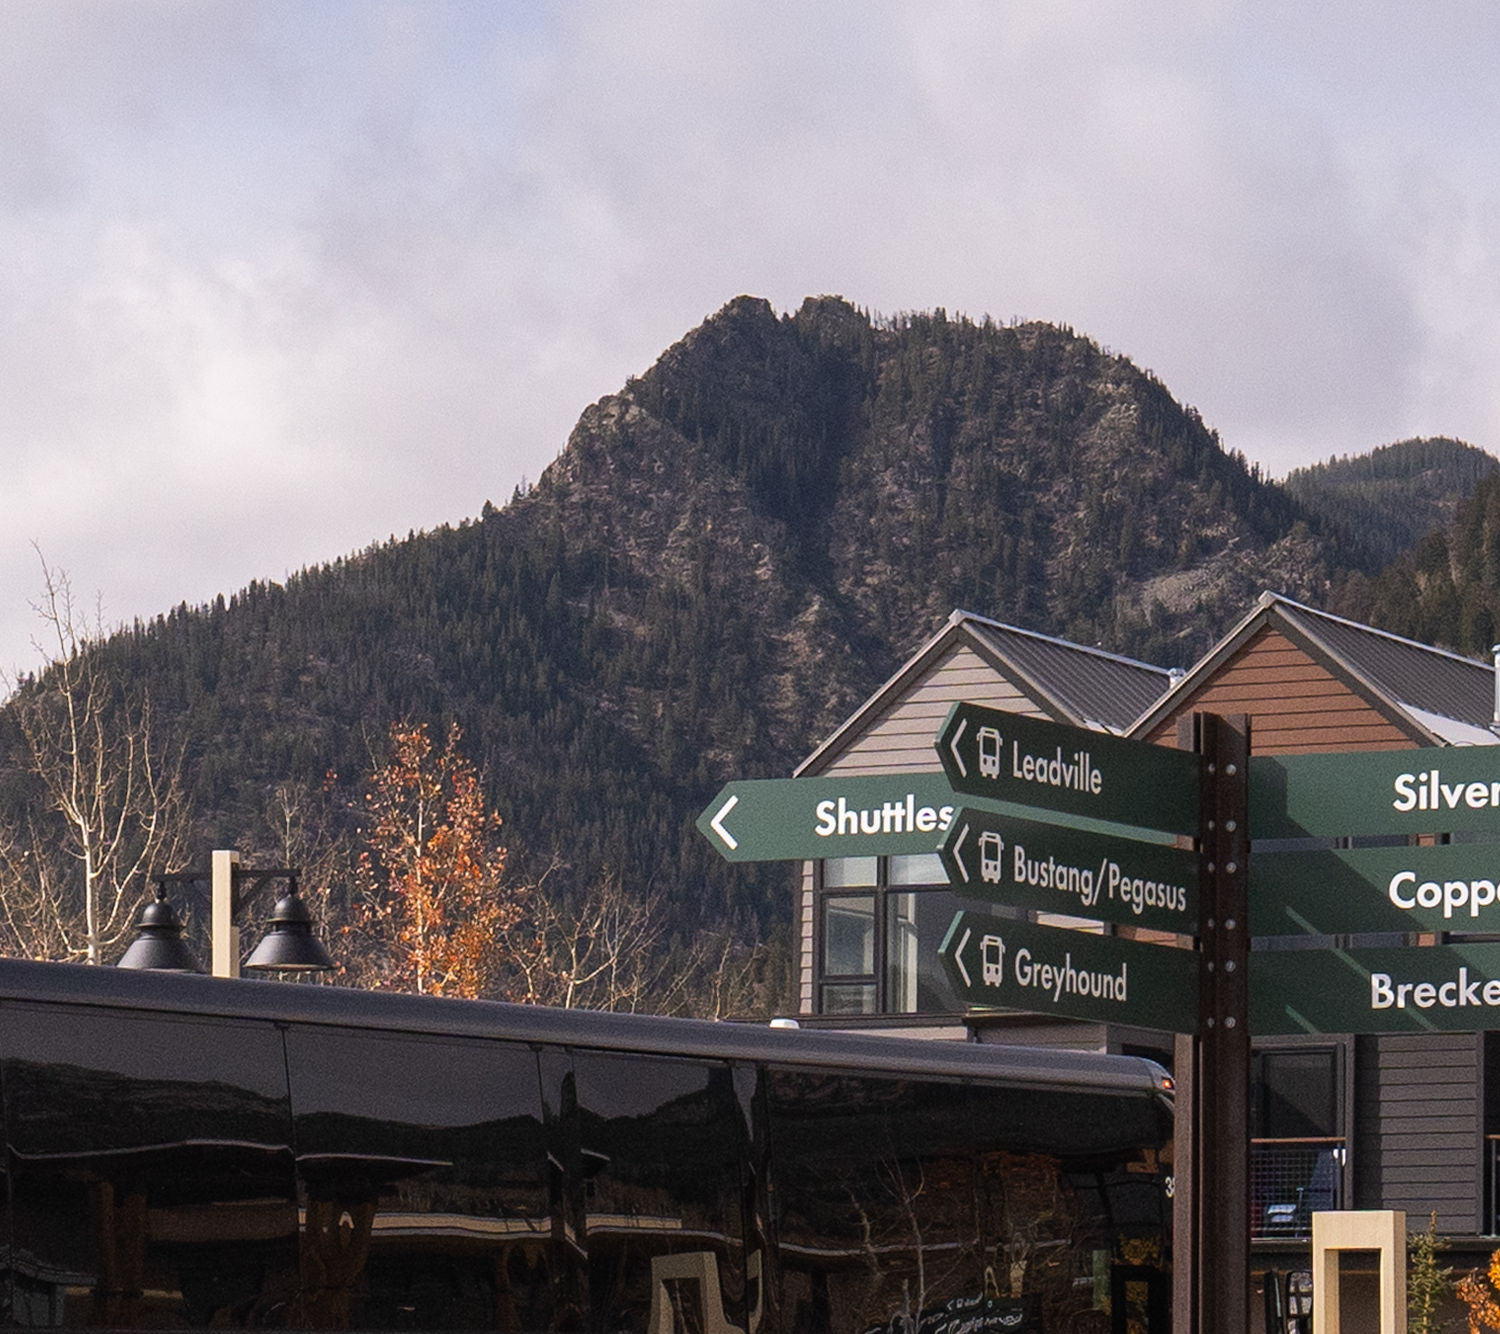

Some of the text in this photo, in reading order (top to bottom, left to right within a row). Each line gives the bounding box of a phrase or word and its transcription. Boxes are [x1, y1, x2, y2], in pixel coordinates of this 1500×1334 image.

[1012, 740, 1103, 795] Leadville
[814, 794, 953, 837] Shuttles
[1013, 845, 1187, 917] Bustang/Pegasus
[1014, 948, 1128, 1002] Greyhound
